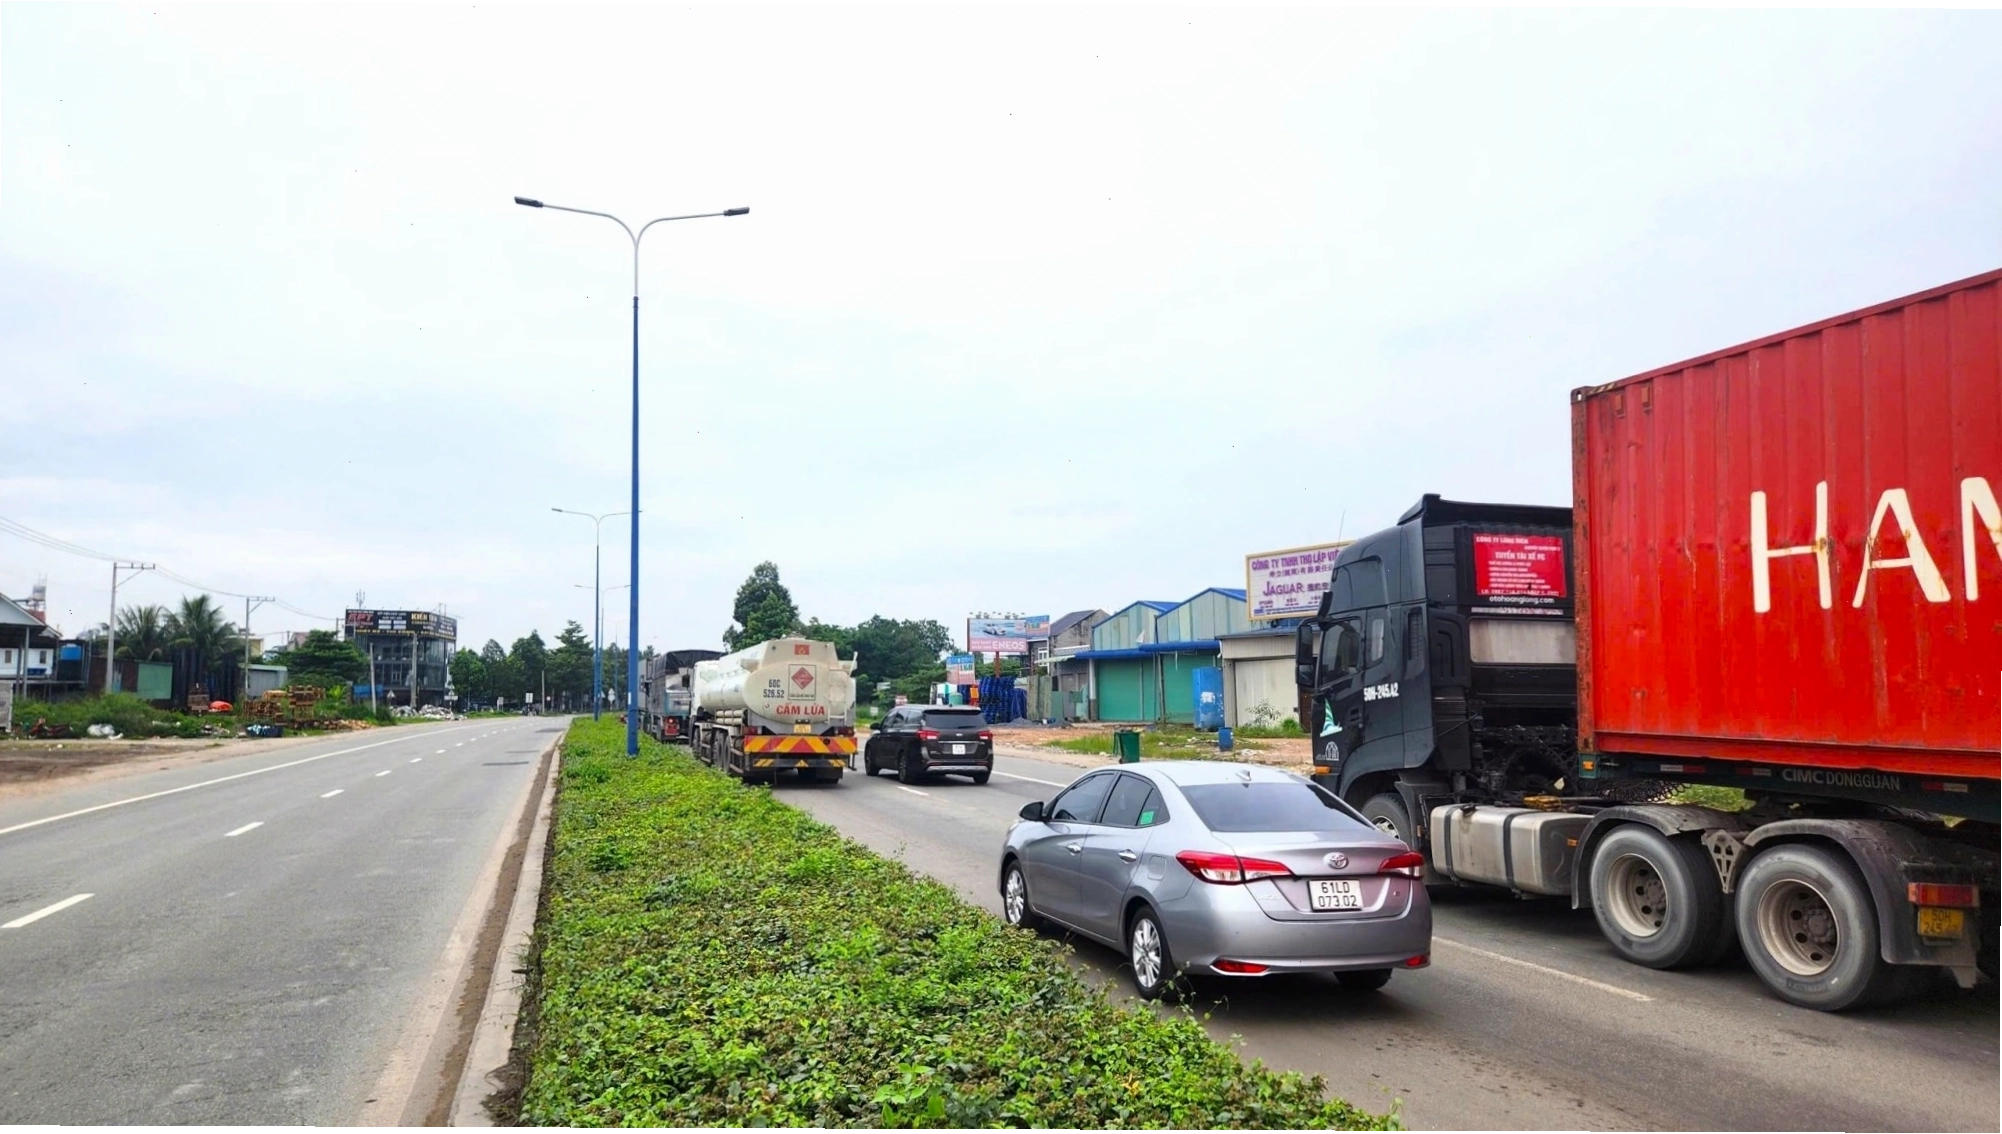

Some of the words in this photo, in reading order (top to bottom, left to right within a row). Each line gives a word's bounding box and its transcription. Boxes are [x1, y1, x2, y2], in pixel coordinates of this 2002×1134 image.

[1271, 558, 1279, 569] TY
[1281, 556, 1298, 567] TNHH
[1263, 581, 1305, 597] JAGUAR
[993, 641, 1025, 650] ENEOS
[776, 702, 801, 716] CẤM
[804, 702, 826, 716] LỬA
[1781, 768, 1825, 785] CIMC
[1826, 771, 1901, 791] DONGGUAN
[1320, 881, 1350, 894] 61LD
[1317, 895, 1358, 908] 073.02
